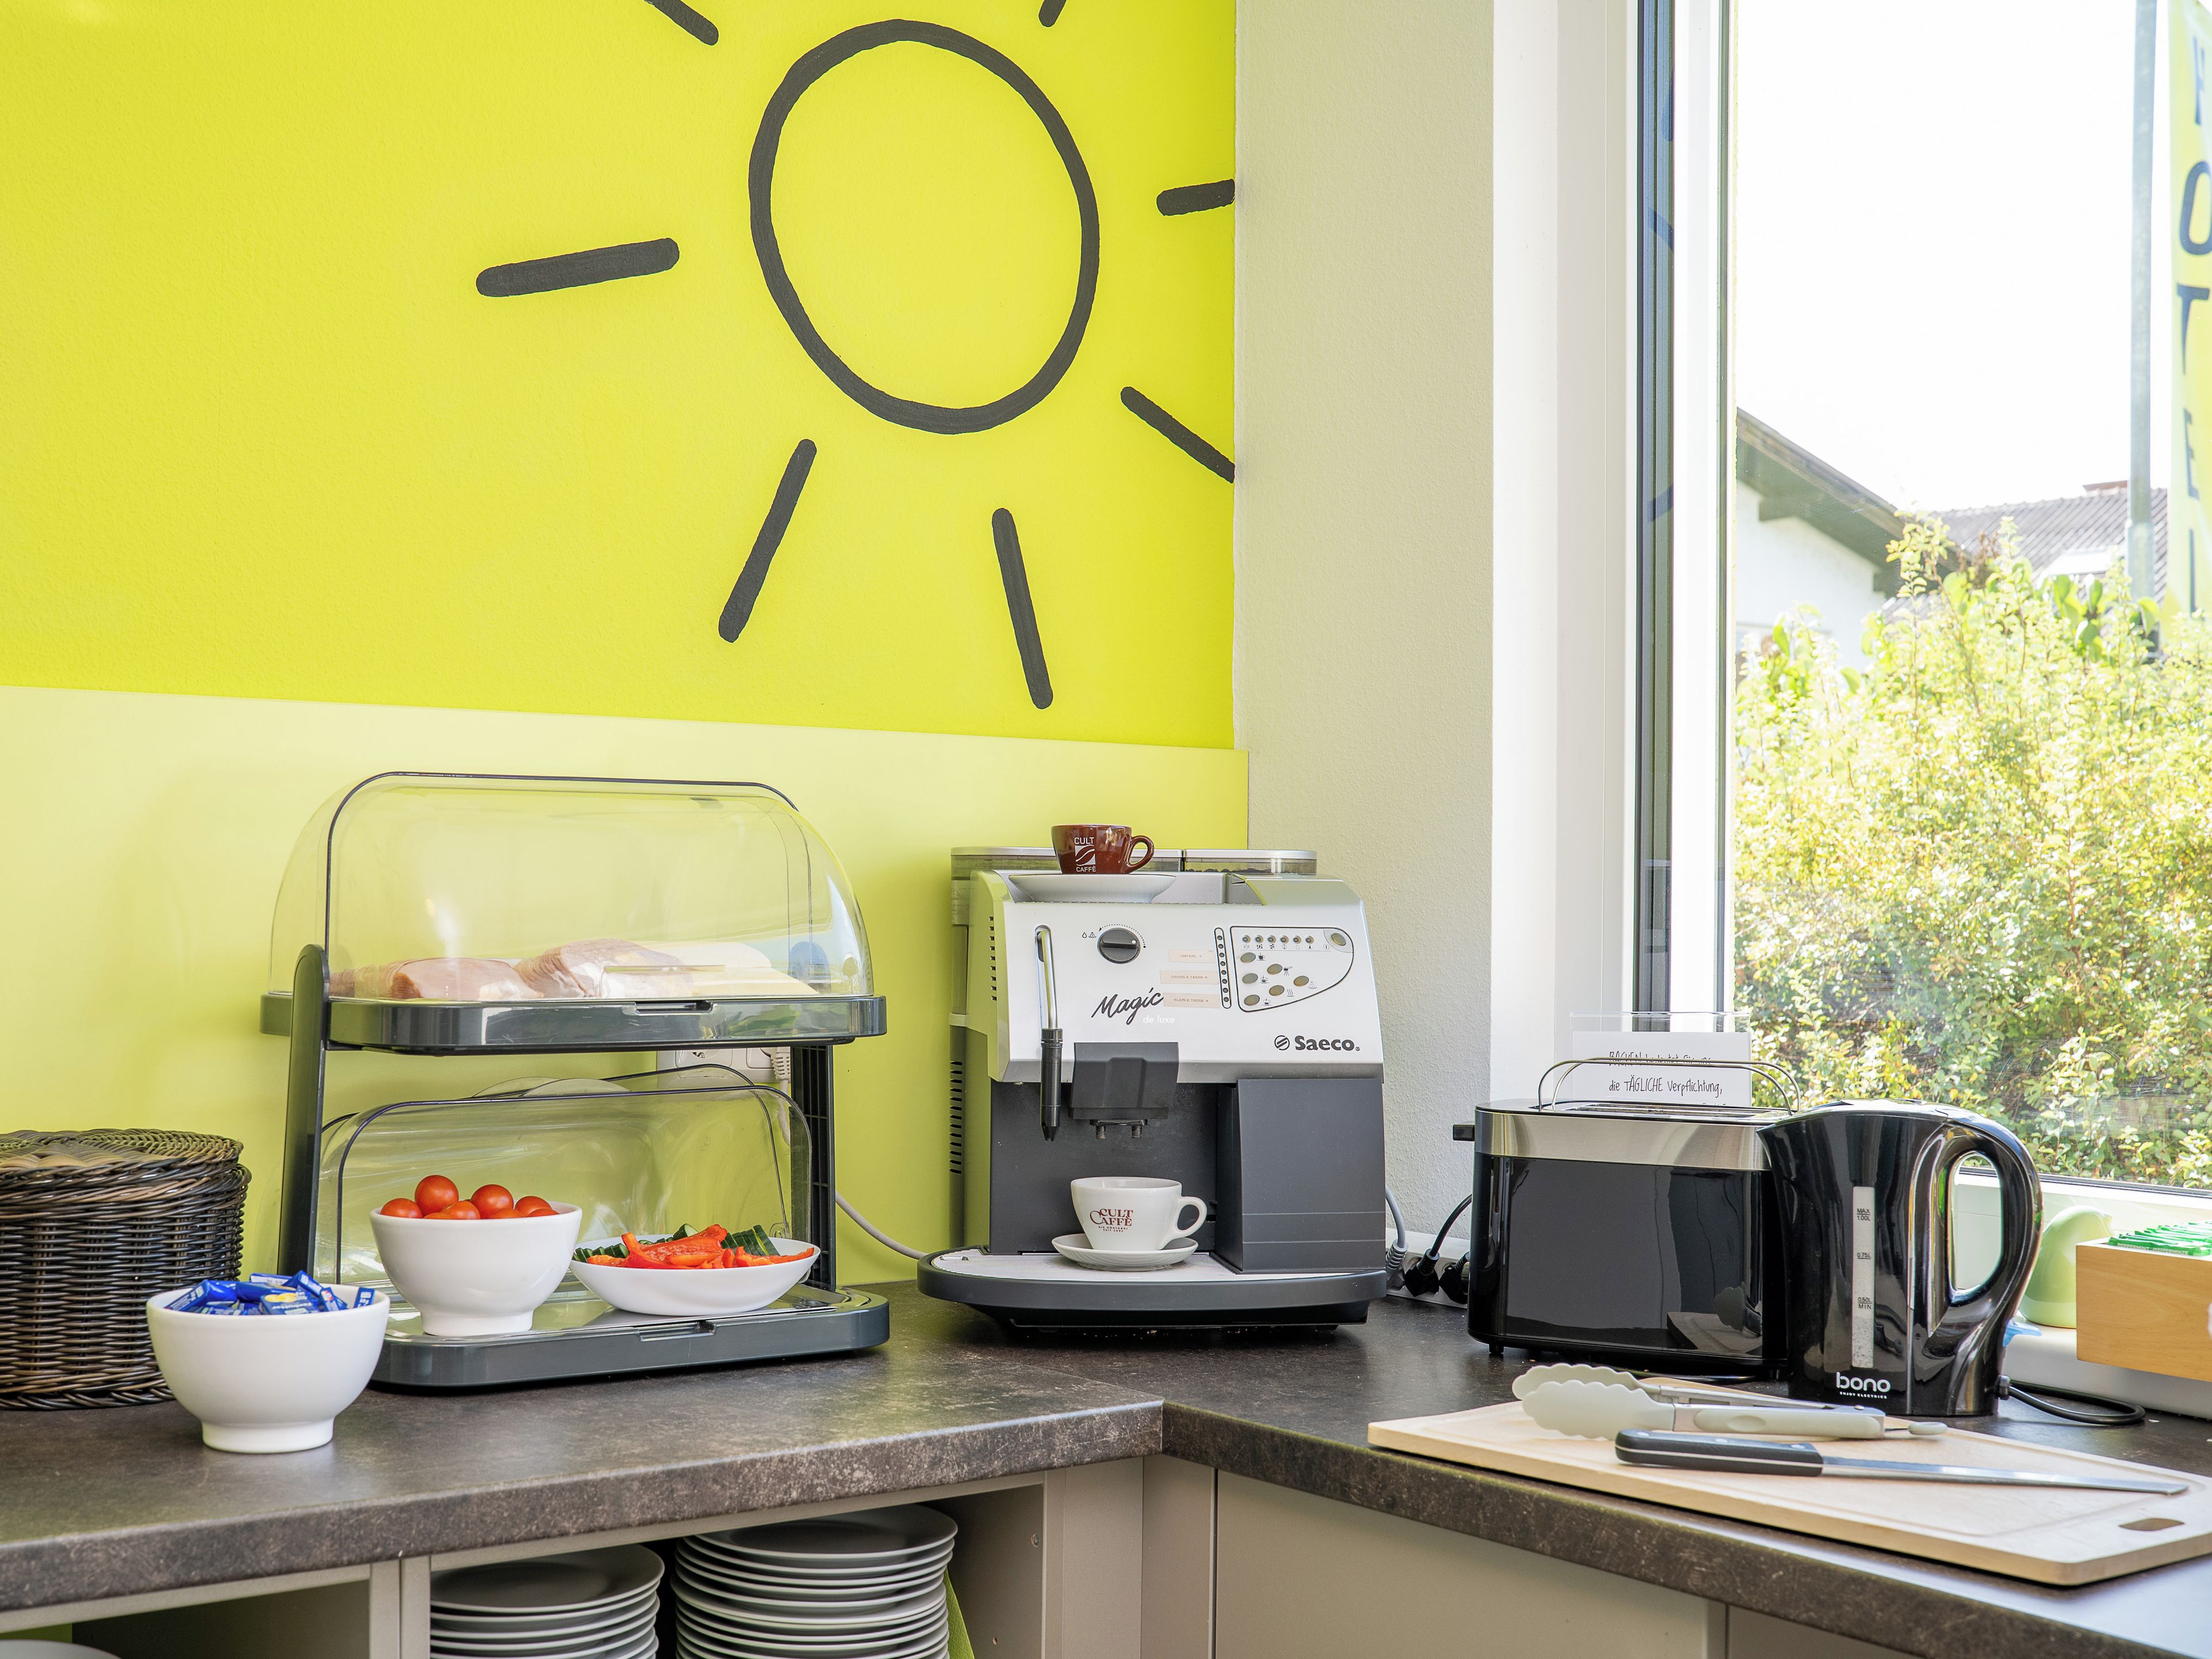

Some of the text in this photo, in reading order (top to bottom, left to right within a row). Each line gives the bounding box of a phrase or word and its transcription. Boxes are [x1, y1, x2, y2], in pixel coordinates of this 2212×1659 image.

[1091, 987, 1164, 1025] Magic
[1142, 1014, 1175, 1023] de luxe
[1294, 1035, 1355, 1051] Saeco
[1608, 1074, 1723, 1099] die TÄGLICHE Verpflichtung,
[1090, 1210, 1132, 1226] CAFFÈ
[1100, 1209, 1133, 1217] CULT
[1836, 1372, 1891, 1393] bono
